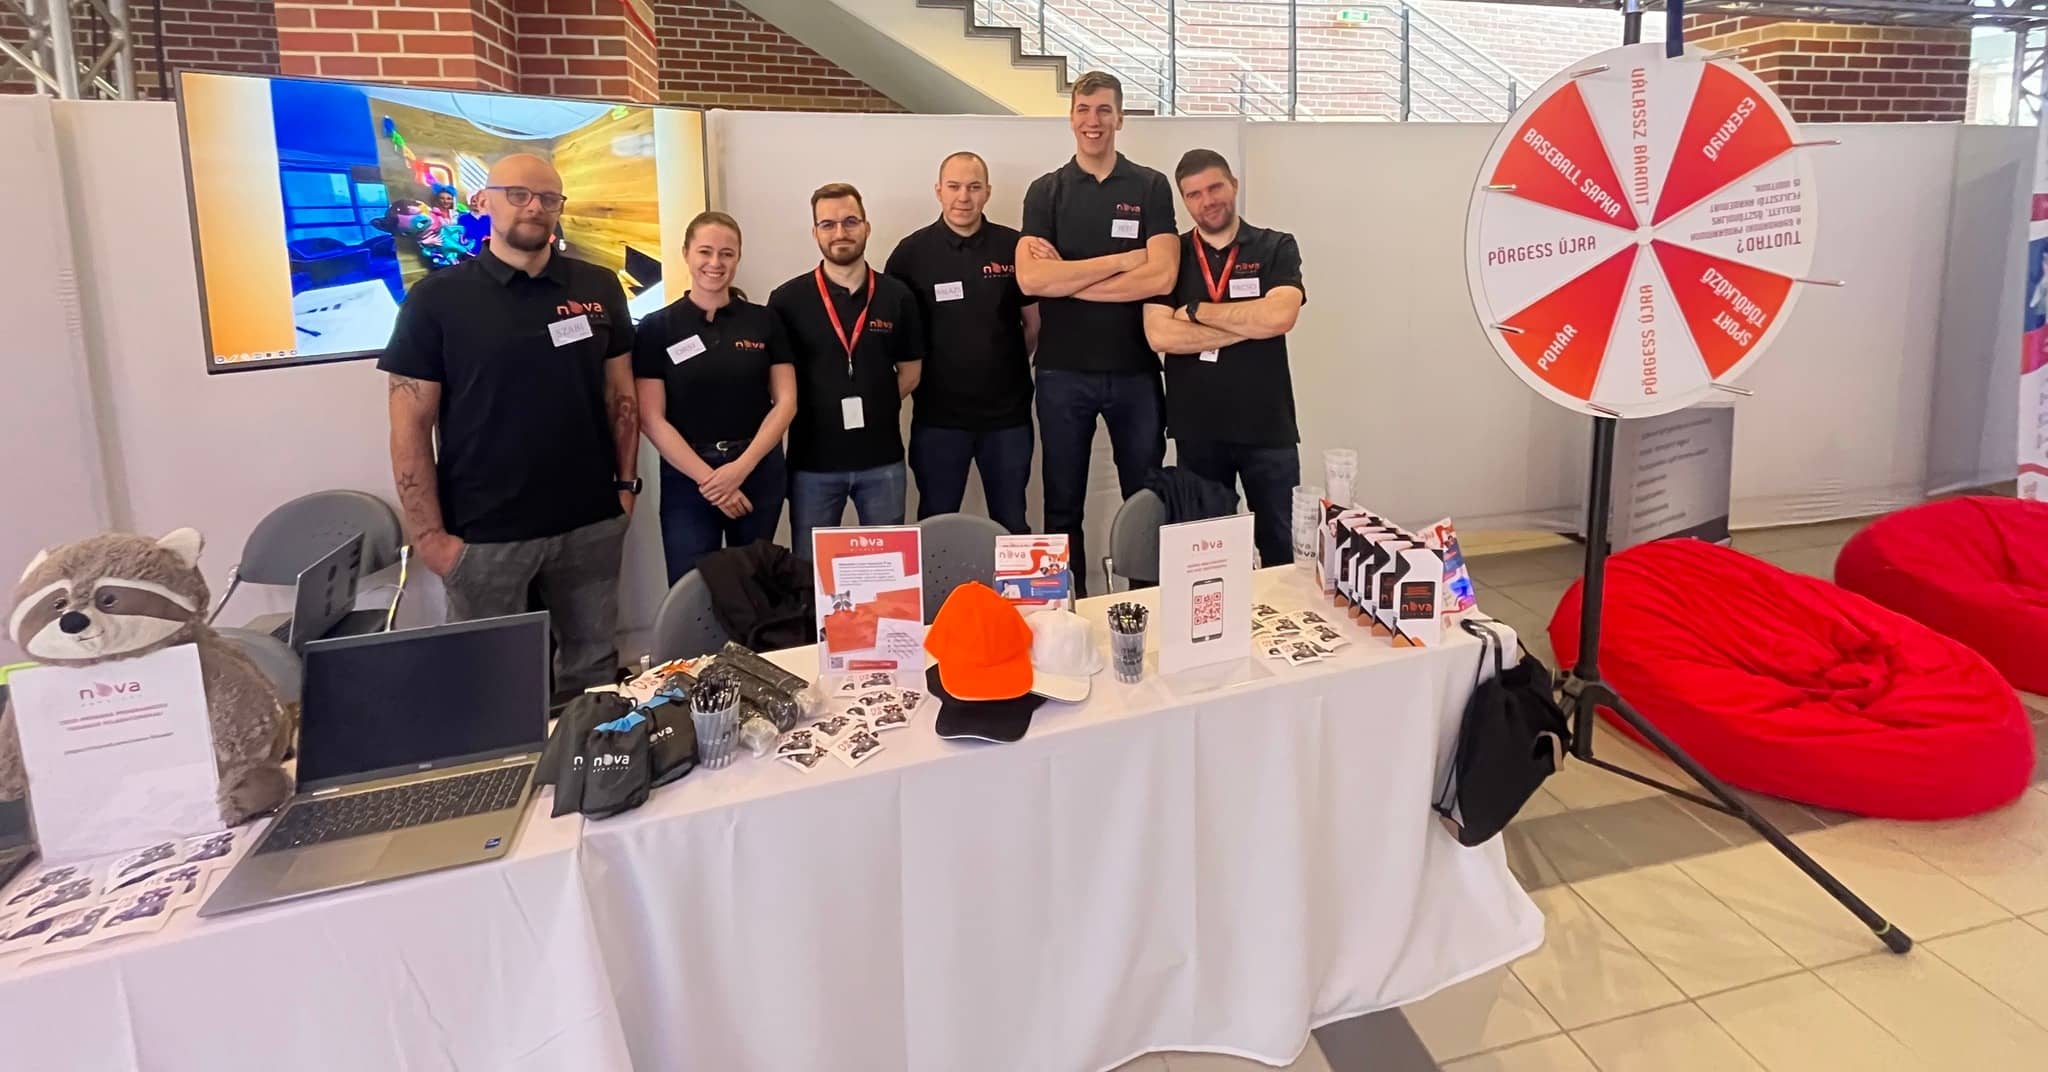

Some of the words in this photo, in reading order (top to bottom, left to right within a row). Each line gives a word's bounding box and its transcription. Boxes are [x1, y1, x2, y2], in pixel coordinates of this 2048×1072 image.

[1631, 68, 1648, 140] VÁLASSZ
[1522, 128, 1582, 186] BASEBALL
[1580, 178, 1622, 218] SAPKA
[1633, 145, 1650, 205] BÁRMIT
[1488, 242, 1553, 266] PÖRGESS
[1559, 236, 1597, 255] ÚJRA
[556, 300, 602, 315] nova
[1638, 284, 1656, 324] ÚJRA
[1712, 311, 1753, 347] SPORT
[1537, 323, 1579, 372] POHÁR
[1640, 329, 1658, 396] PÖRGESS
[850, 536, 884, 548] nova
[1000, 549, 1026, 559] nova
[1192, 538, 1224, 552] nova
[1401, 600, 1433, 612] nova
[80, 681, 142, 700] nova
[650, 726, 673, 742] ova
[593, 754, 630, 766] nova
